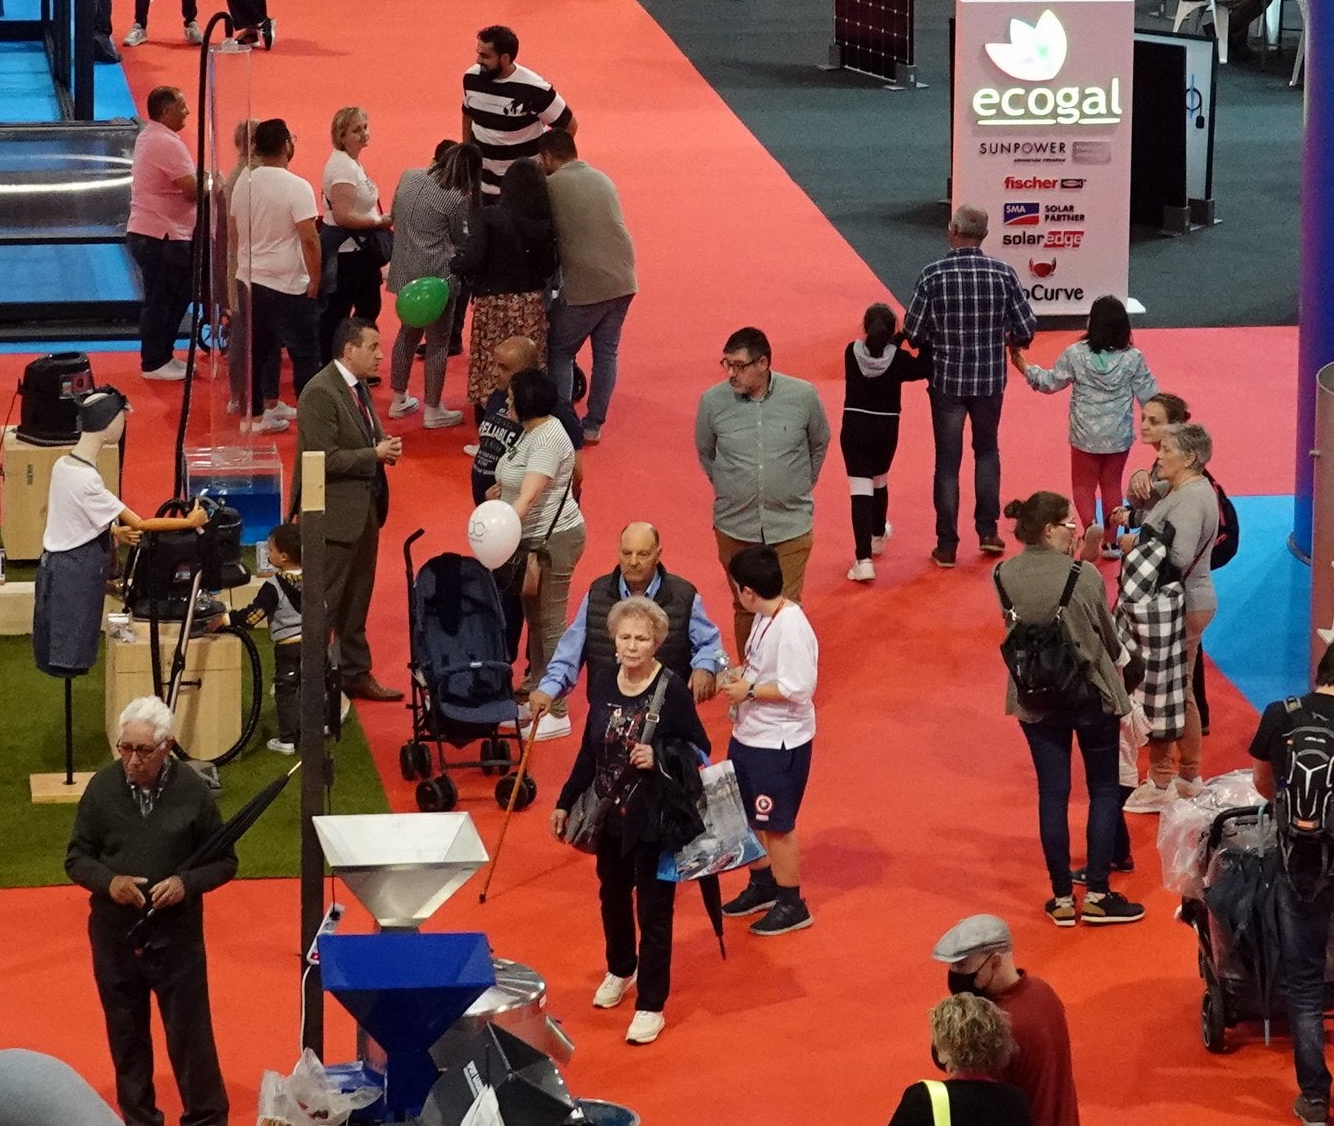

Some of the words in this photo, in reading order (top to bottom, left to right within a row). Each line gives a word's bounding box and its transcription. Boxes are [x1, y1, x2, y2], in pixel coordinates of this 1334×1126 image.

[972, 77, 1123, 125] ecogal
[979, 141, 1067, 156] SUNPOWER
[1004, 176, 1058, 190] fischer
[1005, 204, 1027, 214] SMA
[1044, 204, 1075, 214] SOLAR
[1044, 214, 1085, 223] PARTNER
